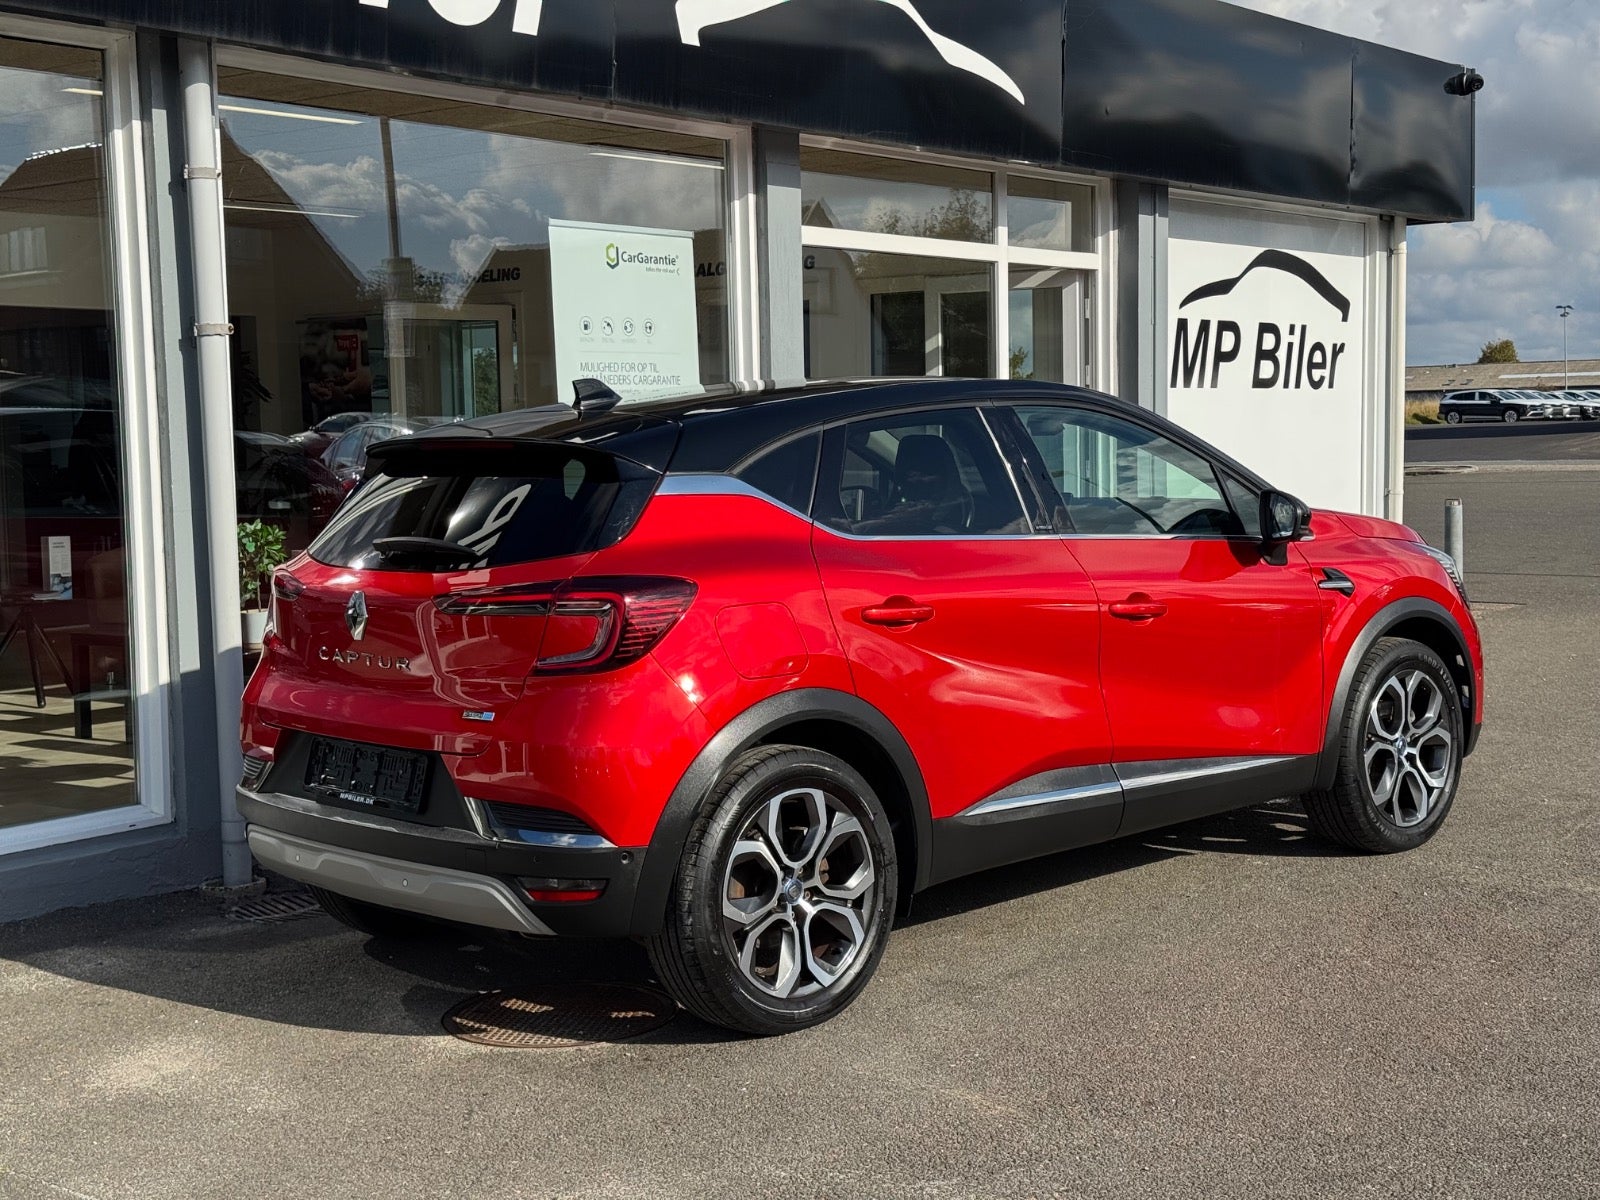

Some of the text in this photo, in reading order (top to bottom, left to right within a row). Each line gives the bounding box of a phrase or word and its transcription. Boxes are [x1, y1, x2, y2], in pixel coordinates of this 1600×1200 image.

[621, 251, 677, 266] CarGarantie
[1170, 318, 1346, 390] MP Biler
[580, 362, 660, 374] MULIGHED FOR OP TIL
[632, 374, 681, 386] CARGARANTIE
[318, 646, 411, 672] CAPTUR
